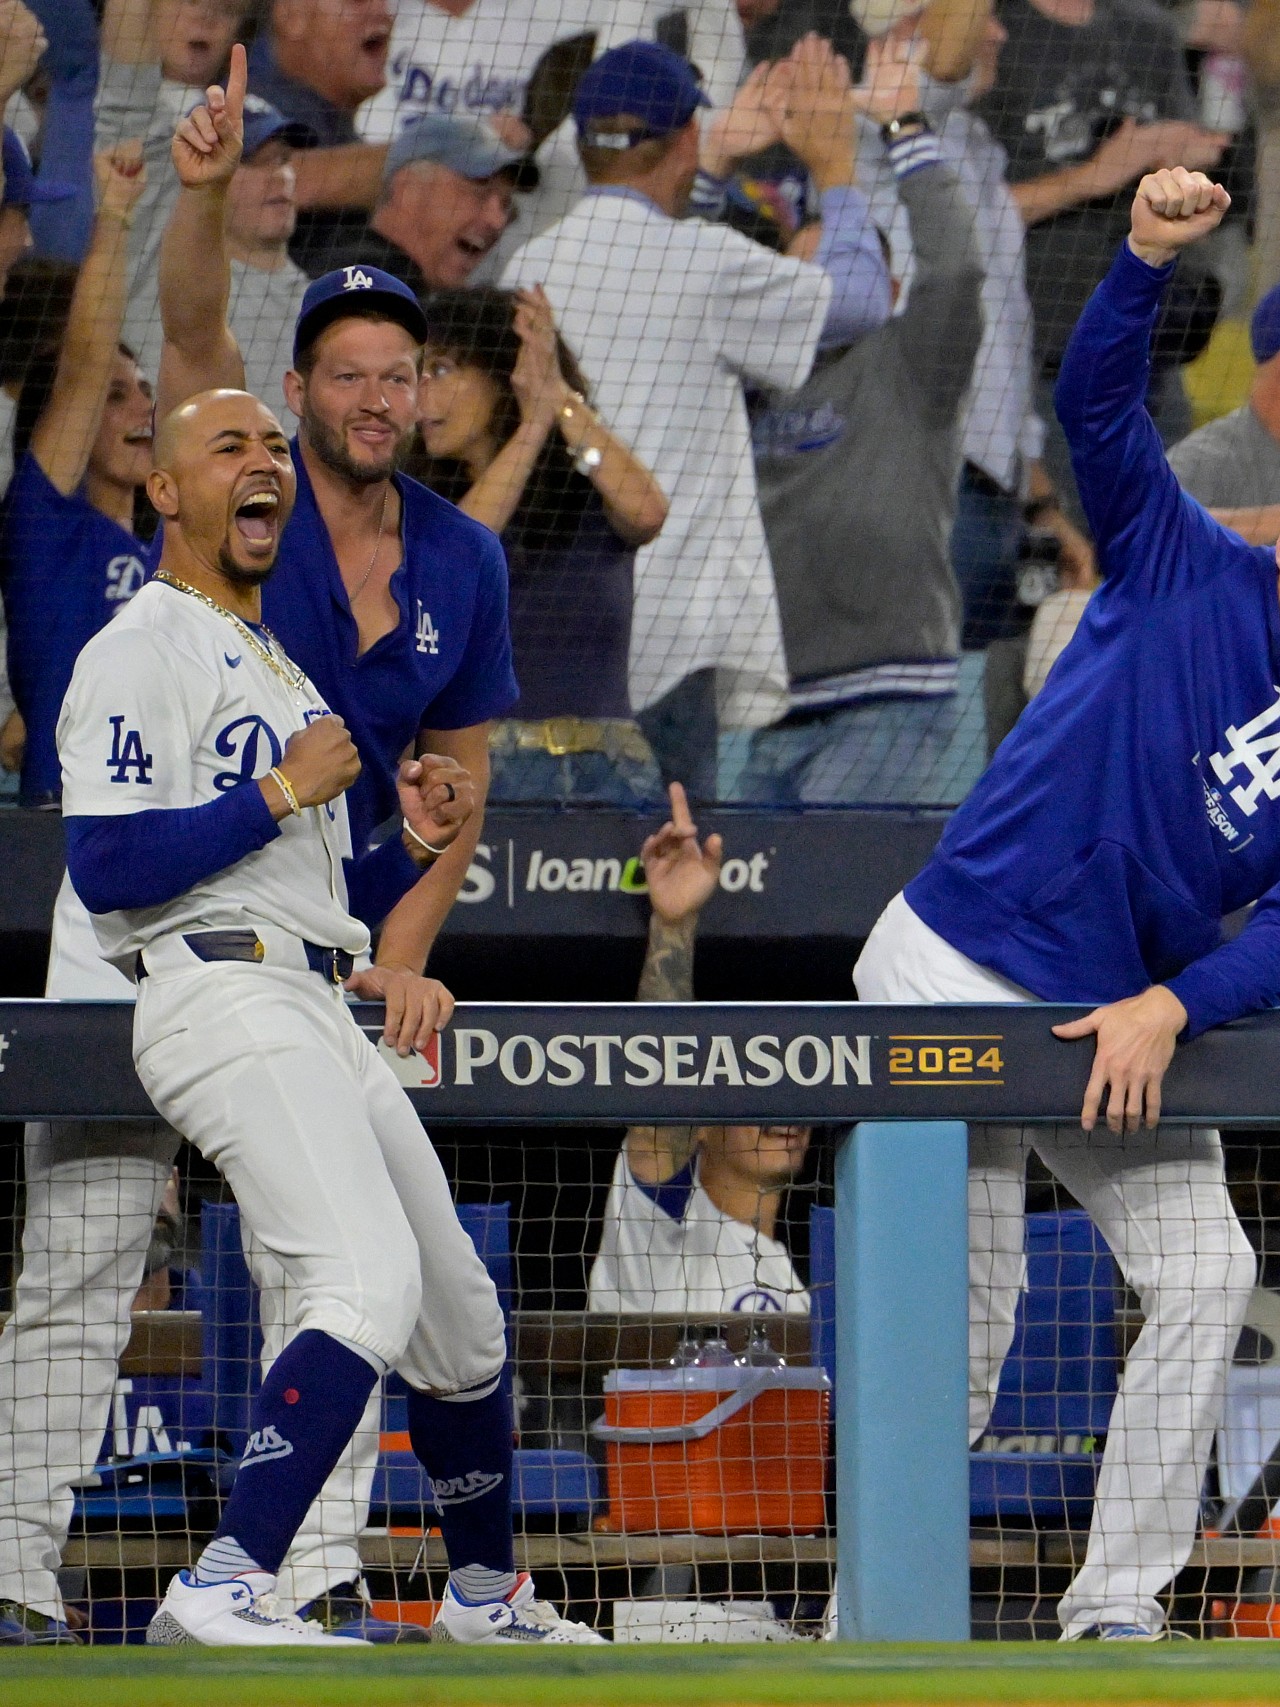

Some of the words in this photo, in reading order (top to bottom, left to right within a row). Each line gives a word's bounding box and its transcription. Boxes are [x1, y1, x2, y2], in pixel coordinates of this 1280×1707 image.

[342, 265, 373, 290] LA
[415, 598, 439, 655] LA
[106, 714, 153, 785] LA
[453, 1028, 873, 1087] POSTSEASON
[888, 1046, 1005, 1074] 2024
